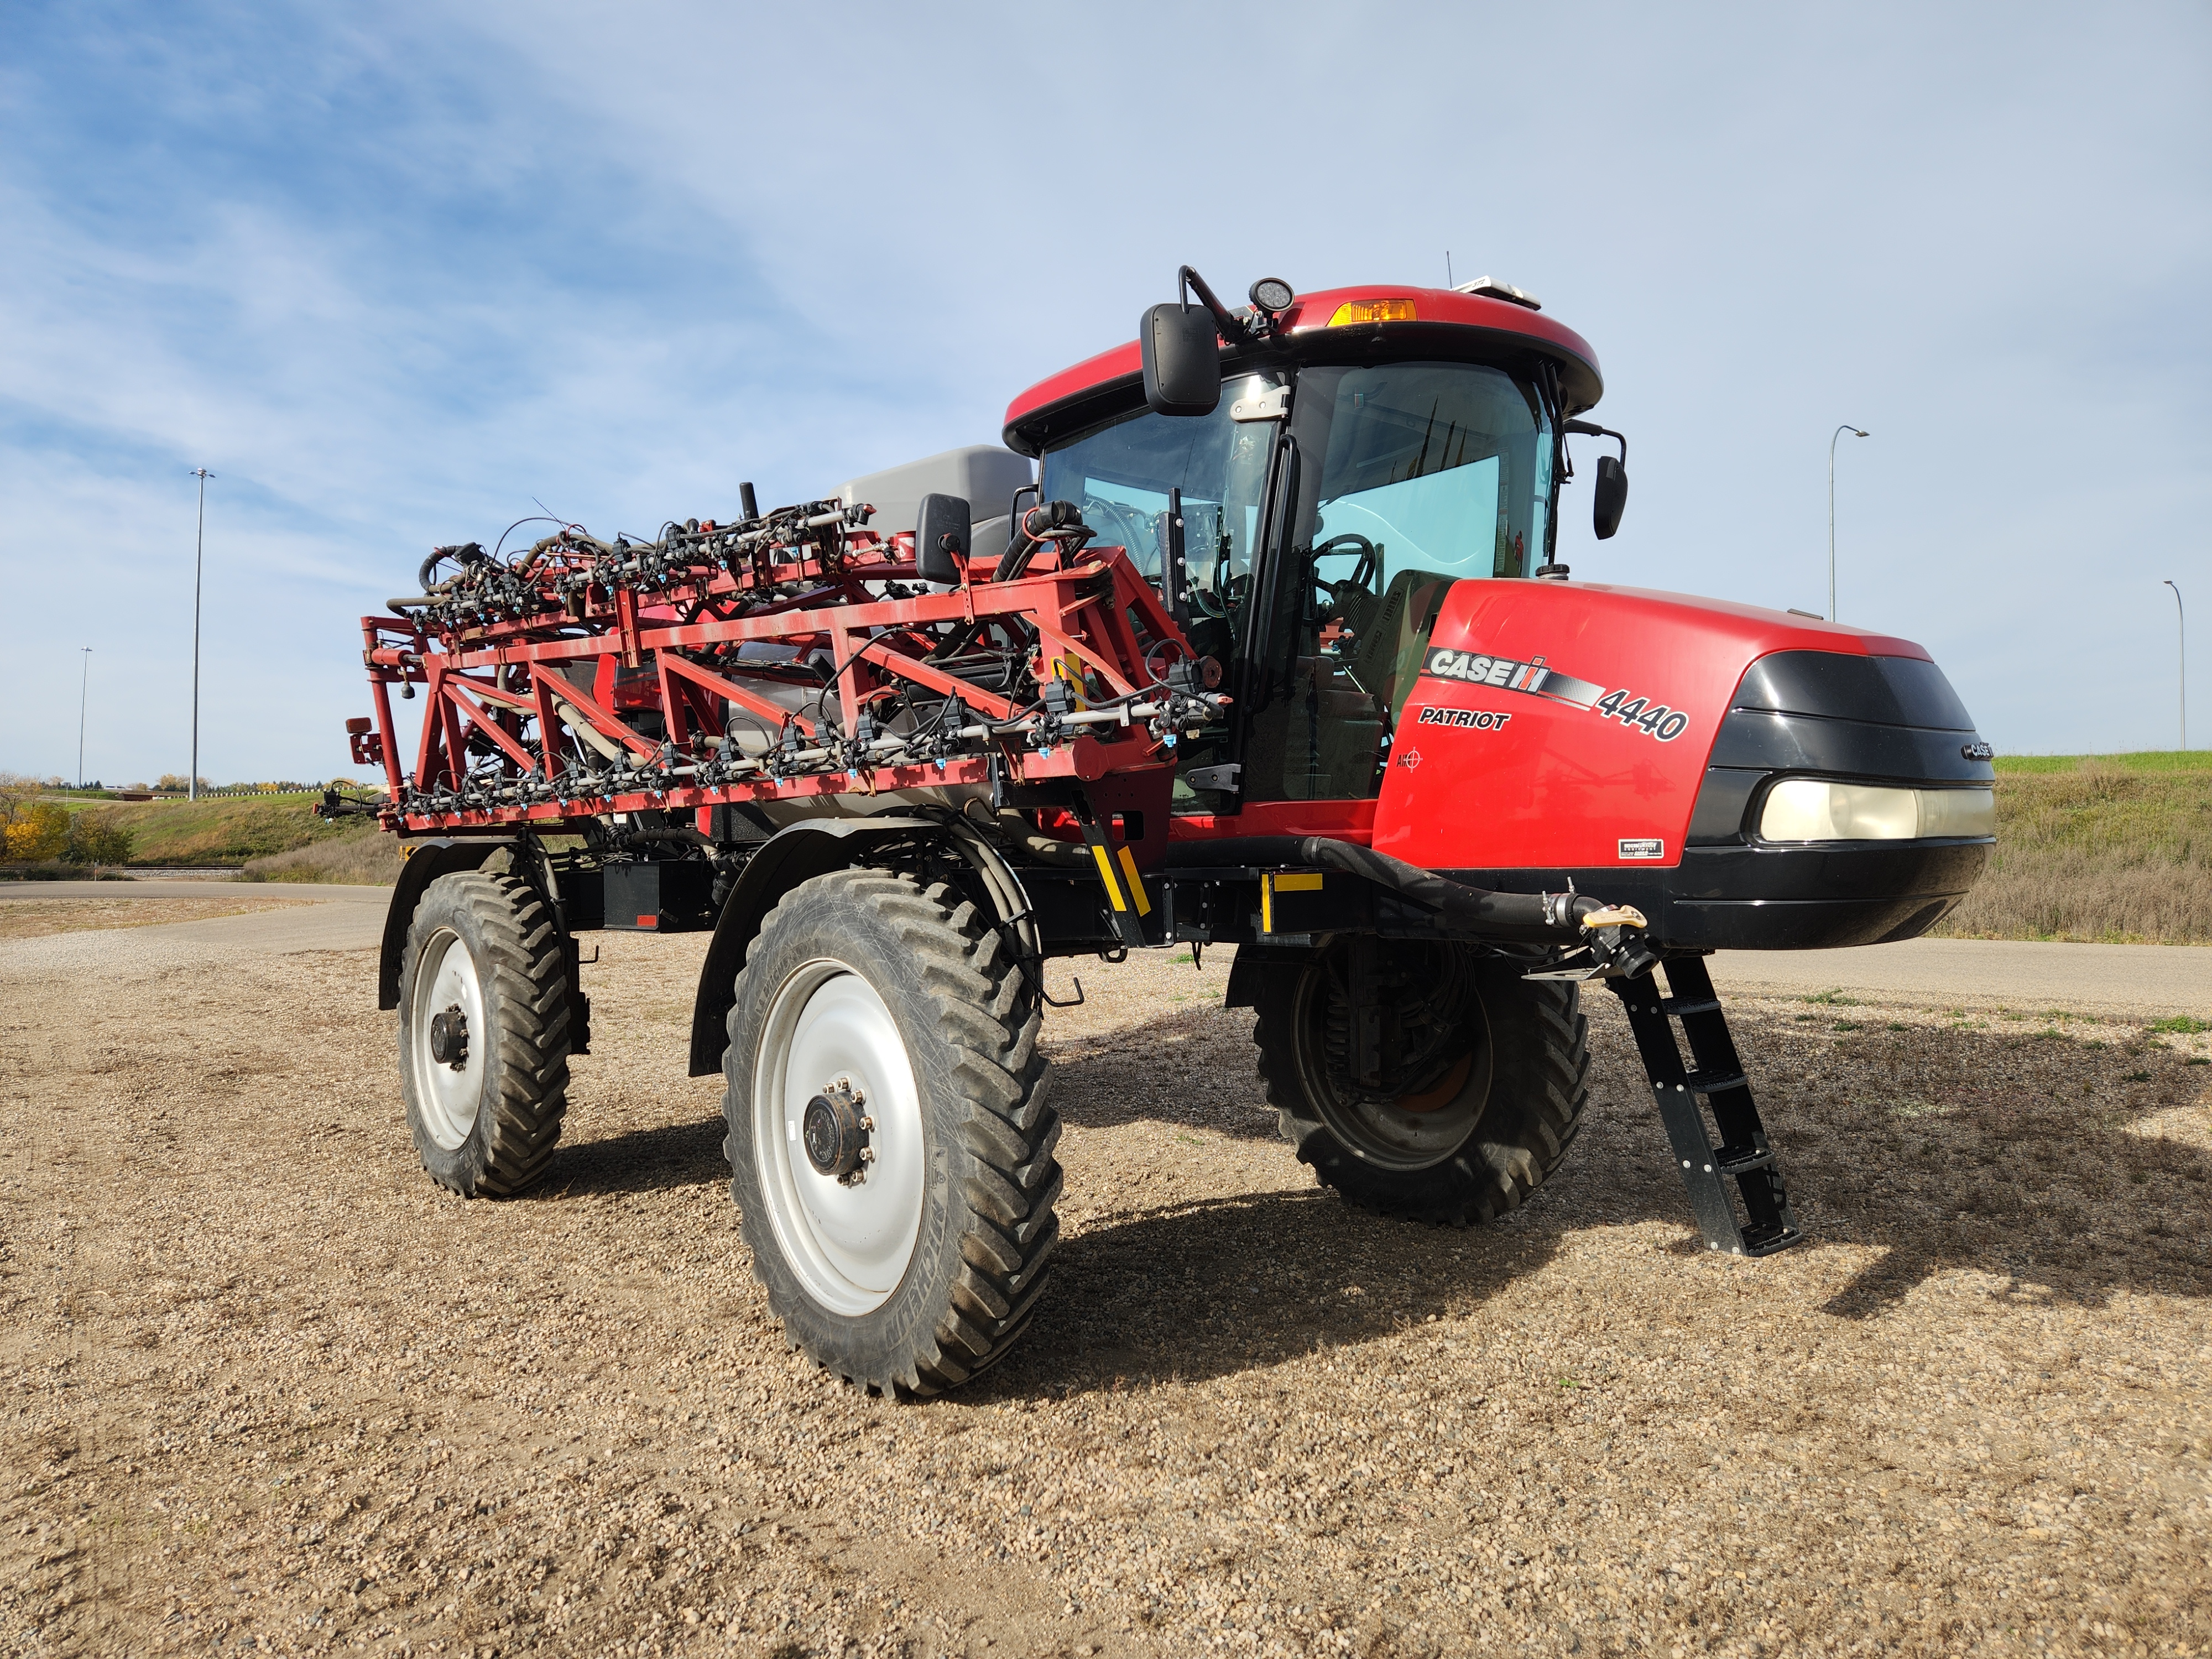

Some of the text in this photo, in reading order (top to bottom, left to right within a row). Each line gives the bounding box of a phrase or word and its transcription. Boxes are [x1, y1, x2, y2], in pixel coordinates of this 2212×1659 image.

[1430, 649, 1515, 686] CASE
[1418, 707, 1511, 731] PATRIOT
[1595, 689, 1689, 742] 4440
[1971, 744, 1990, 757] CASE
[885, 1193, 946, 1349] MICHELIN
